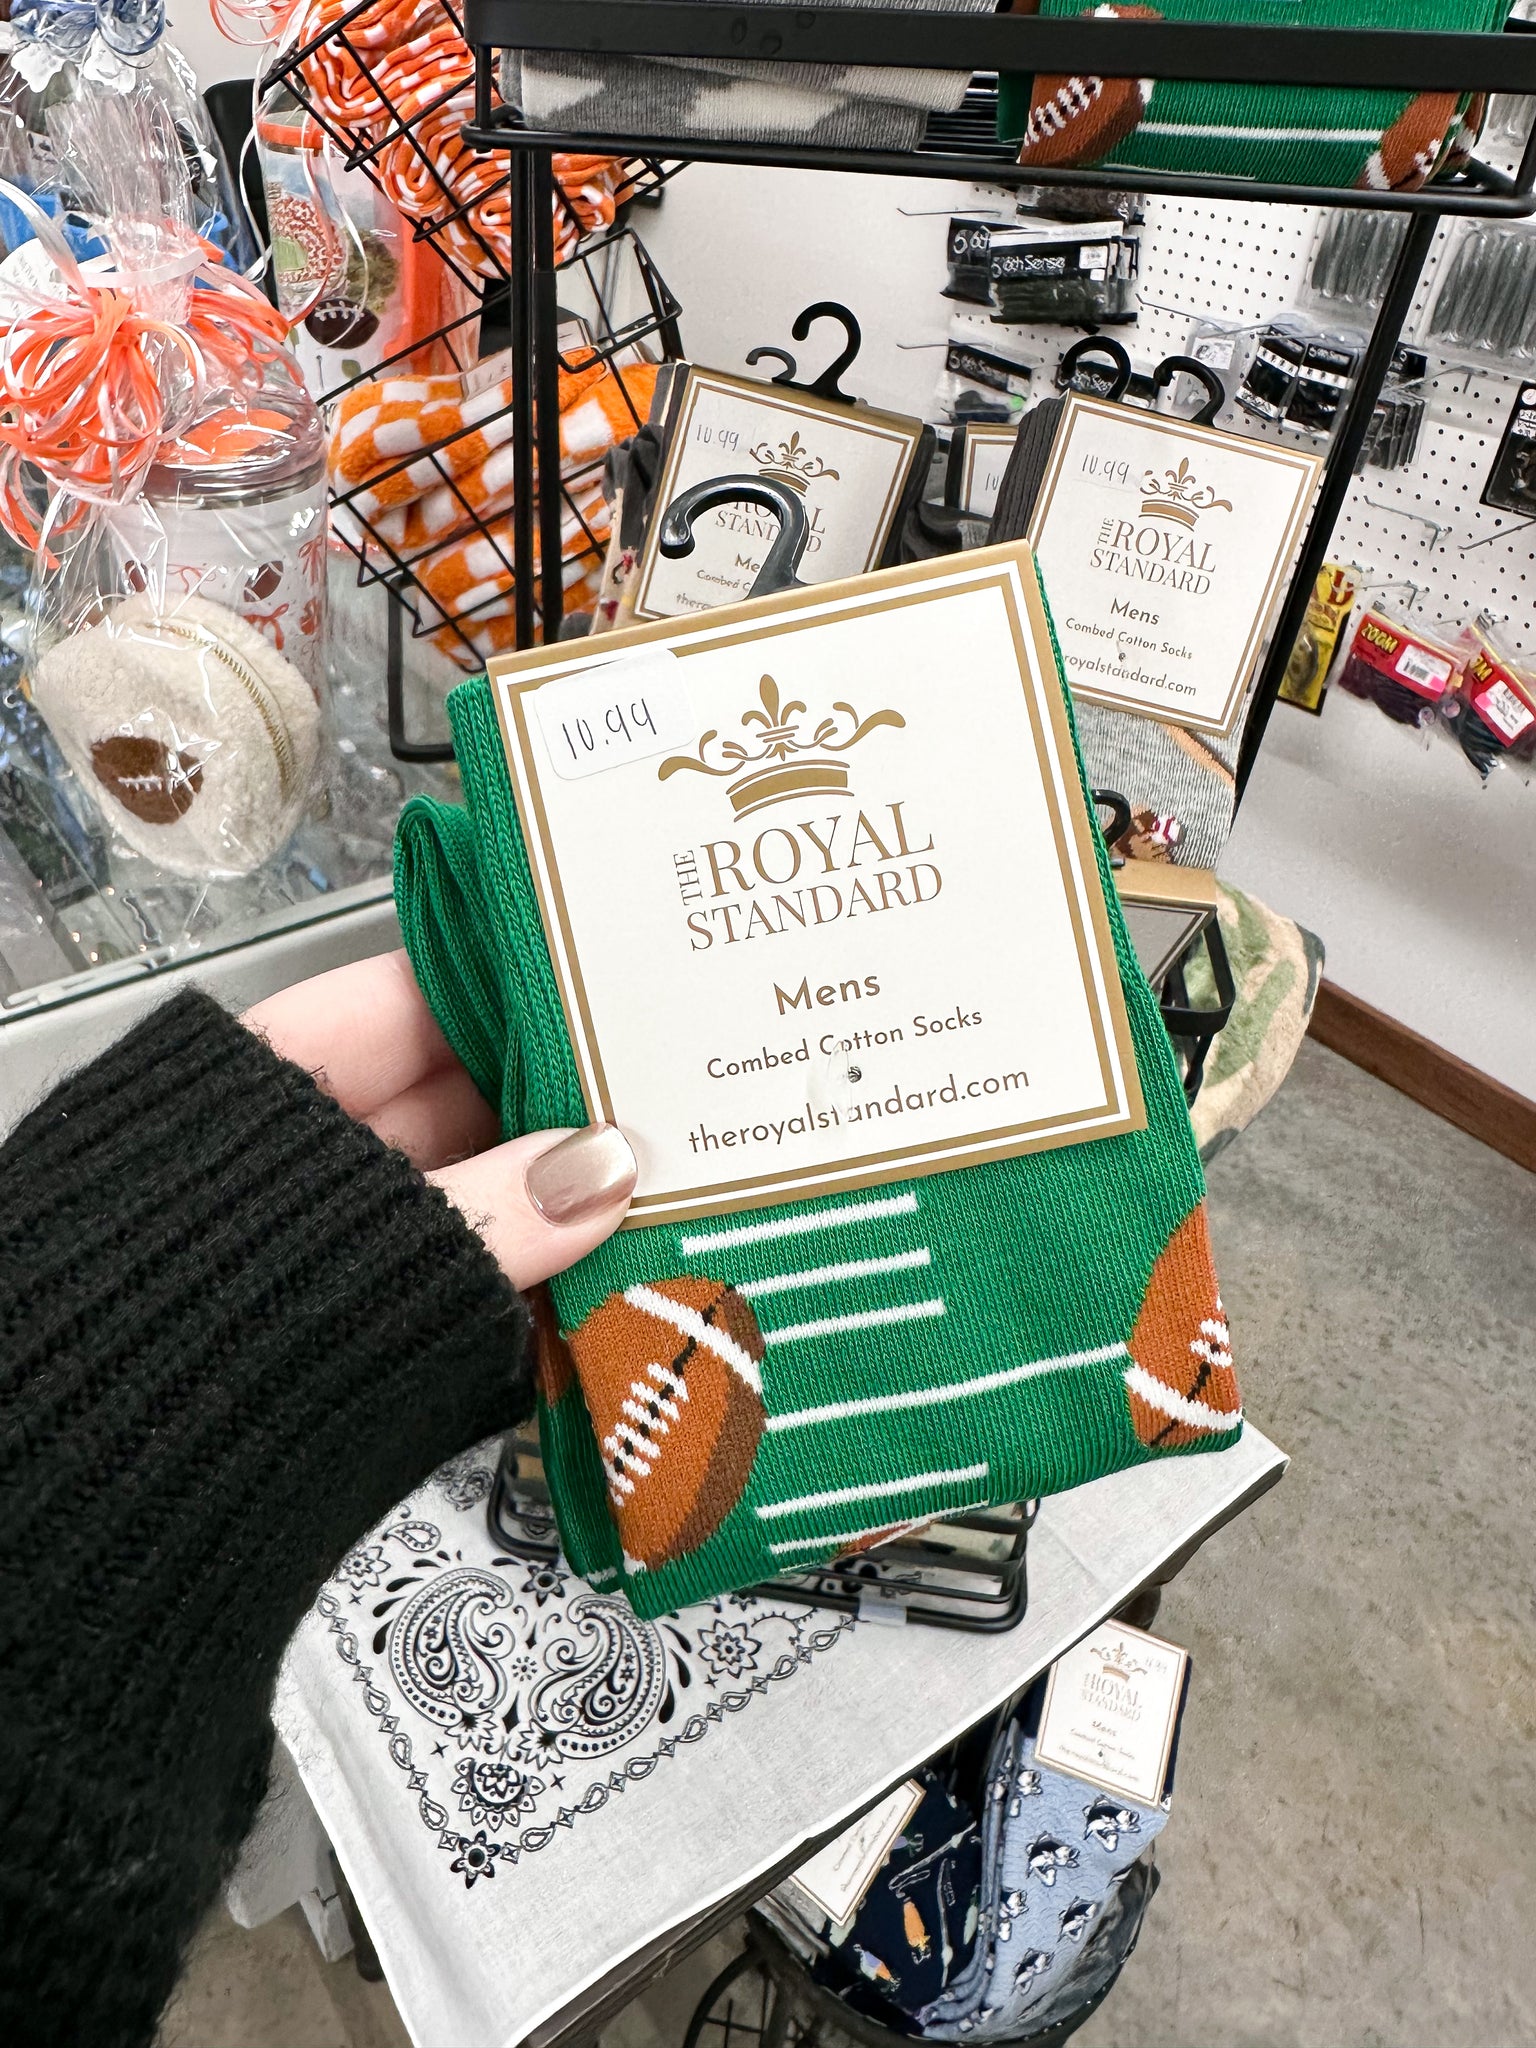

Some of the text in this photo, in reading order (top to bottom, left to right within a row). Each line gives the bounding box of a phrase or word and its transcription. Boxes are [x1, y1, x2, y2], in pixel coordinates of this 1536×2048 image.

[696, 424, 740, 451] 10.99
[1081, 454, 1130, 484] 10.99
[715, 510, 822, 552] STANDD
[1097, 517, 1115, 545] THE
[1111, 519, 1216, 573] ROYAL
[696, 569, 741, 589] Combed
[734, 553, 760, 573] Me
[1090, 548, 1211, 595] STANDARD
[1110, 597, 1160, 626] Mens
[1065, 617, 1193, 660] Combed Cotton Socks
[1064, 653, 1197, 696] royalstandard.com
[561, 697, 656, 760] 10.99
[700, 801, 935, 898] ROYAL
[674, 849, 704, 906] THE
[685, 862, 944, 952] STANDARD
[773, 971, 881, 1016] Mens
[706, 1007, 983, 1079] Combed Cotton Socks
[689, 1071, 1030, 1154] theroyalstandard.com
